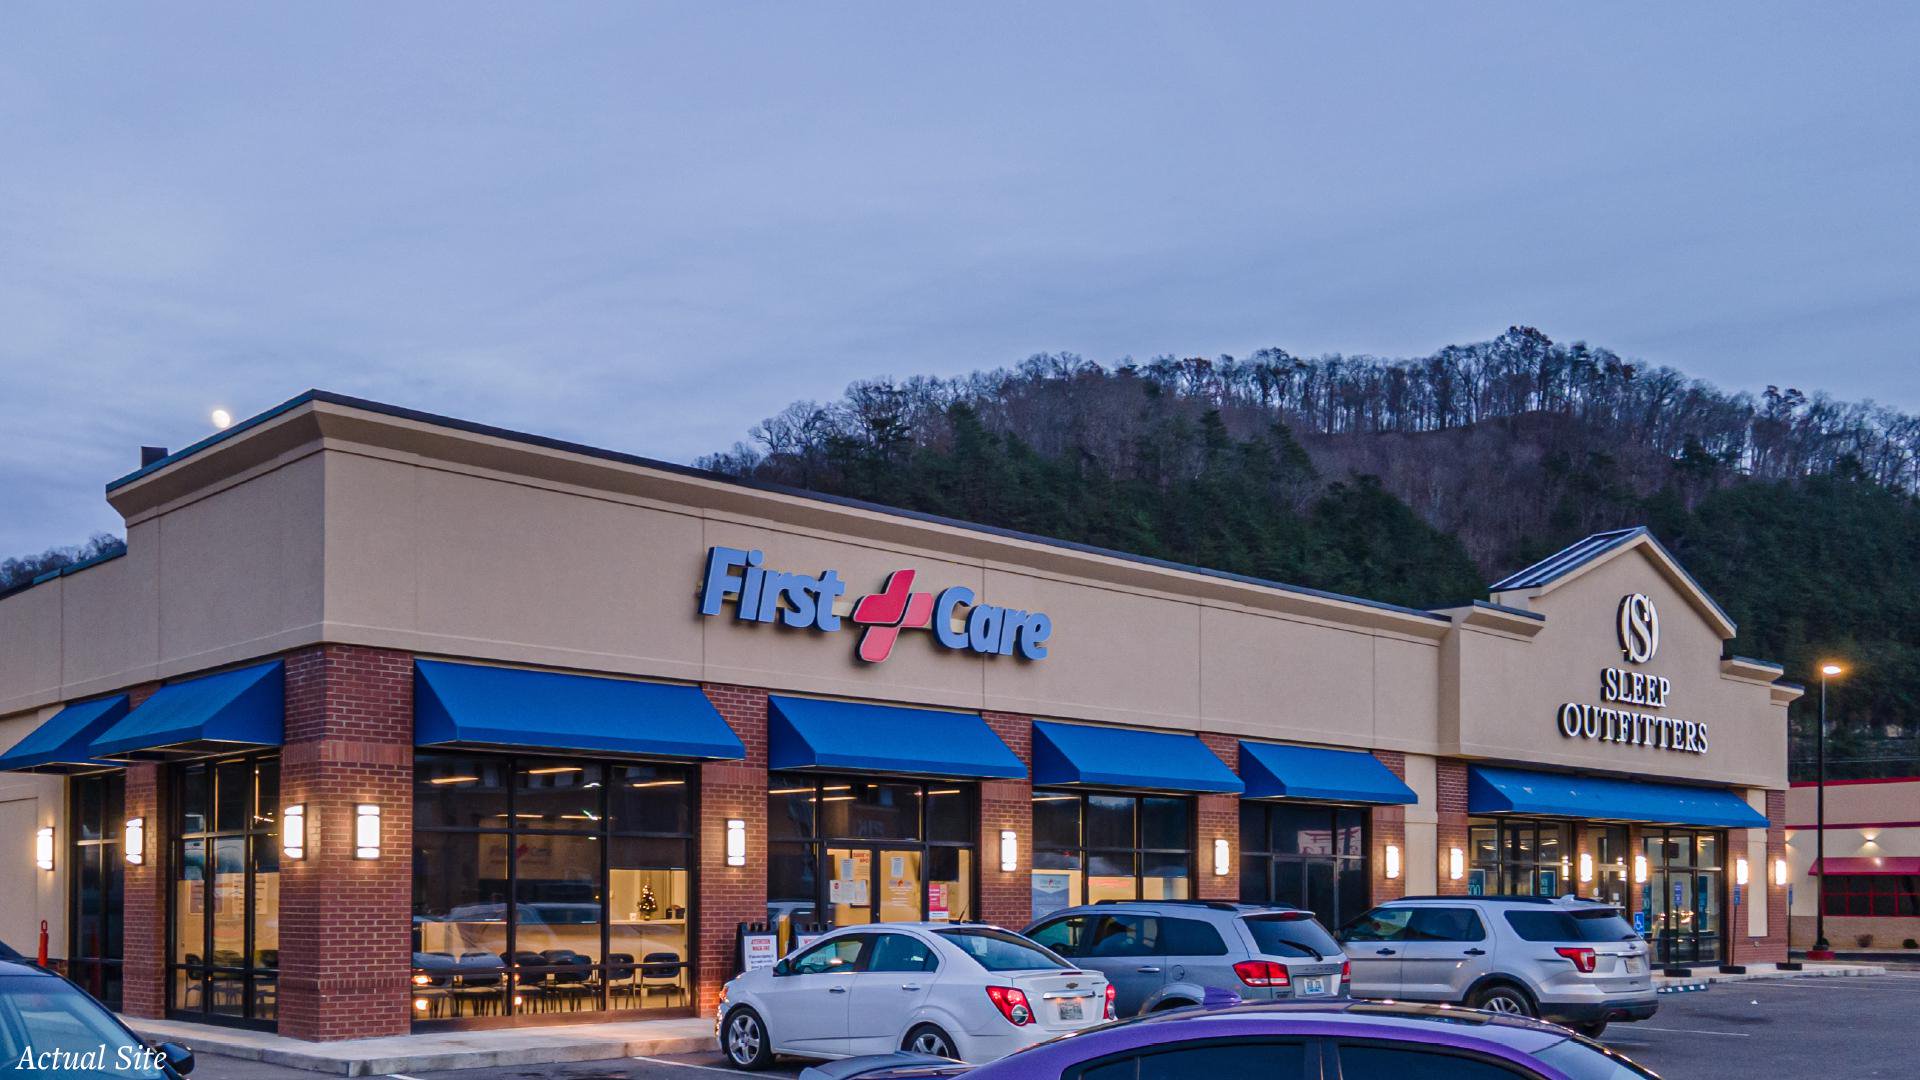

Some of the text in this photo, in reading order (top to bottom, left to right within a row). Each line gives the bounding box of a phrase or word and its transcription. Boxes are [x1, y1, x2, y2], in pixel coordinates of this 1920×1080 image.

[700, 546, 1053, 661] First Care
[1603, 667, 1671, 707] SLEEP
[1560, 702, 1709, 753] OUTFITTERS
